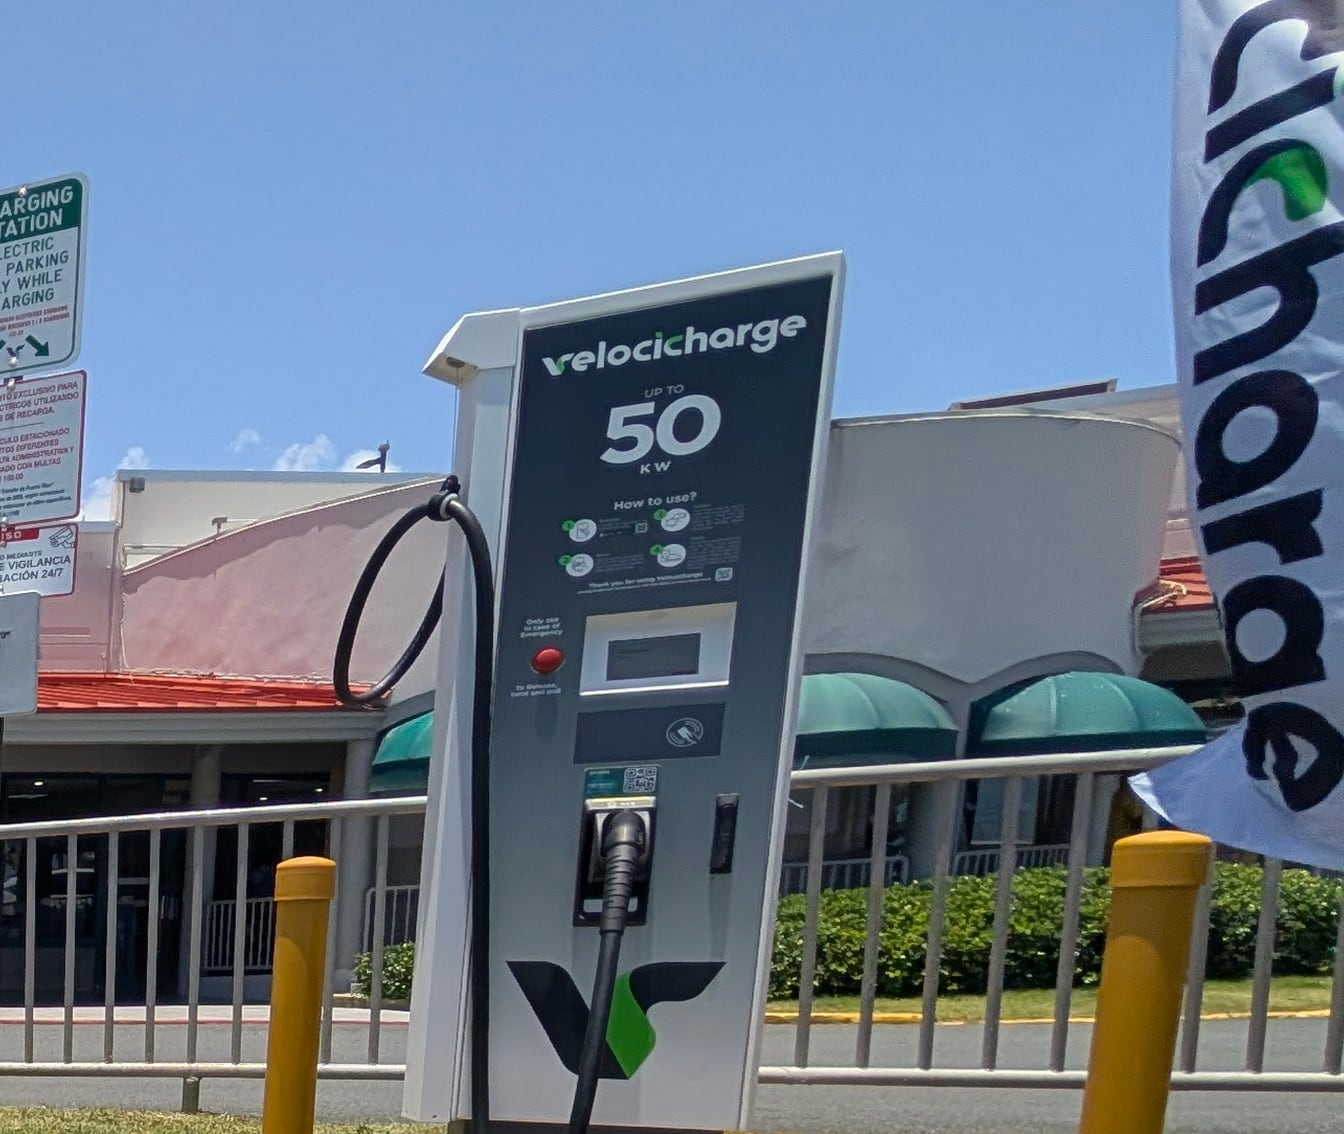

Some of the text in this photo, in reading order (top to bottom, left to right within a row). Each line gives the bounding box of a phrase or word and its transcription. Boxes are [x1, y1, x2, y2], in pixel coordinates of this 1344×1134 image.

[6, 250, 69, 275] PARKING
[18, 268, 62, 290] WHILE
[542, 314, 807, 376] velocicharge
[57, 381, 78, 392] PARA
[645, 384, 684, 398] UP TO
[600, 394, 721, 464] 50
[614, 491, 697, 510] How to use?
[8, 555, 71, 570] VIGILANCIA
[41, 567, 64, 580] 24/7
